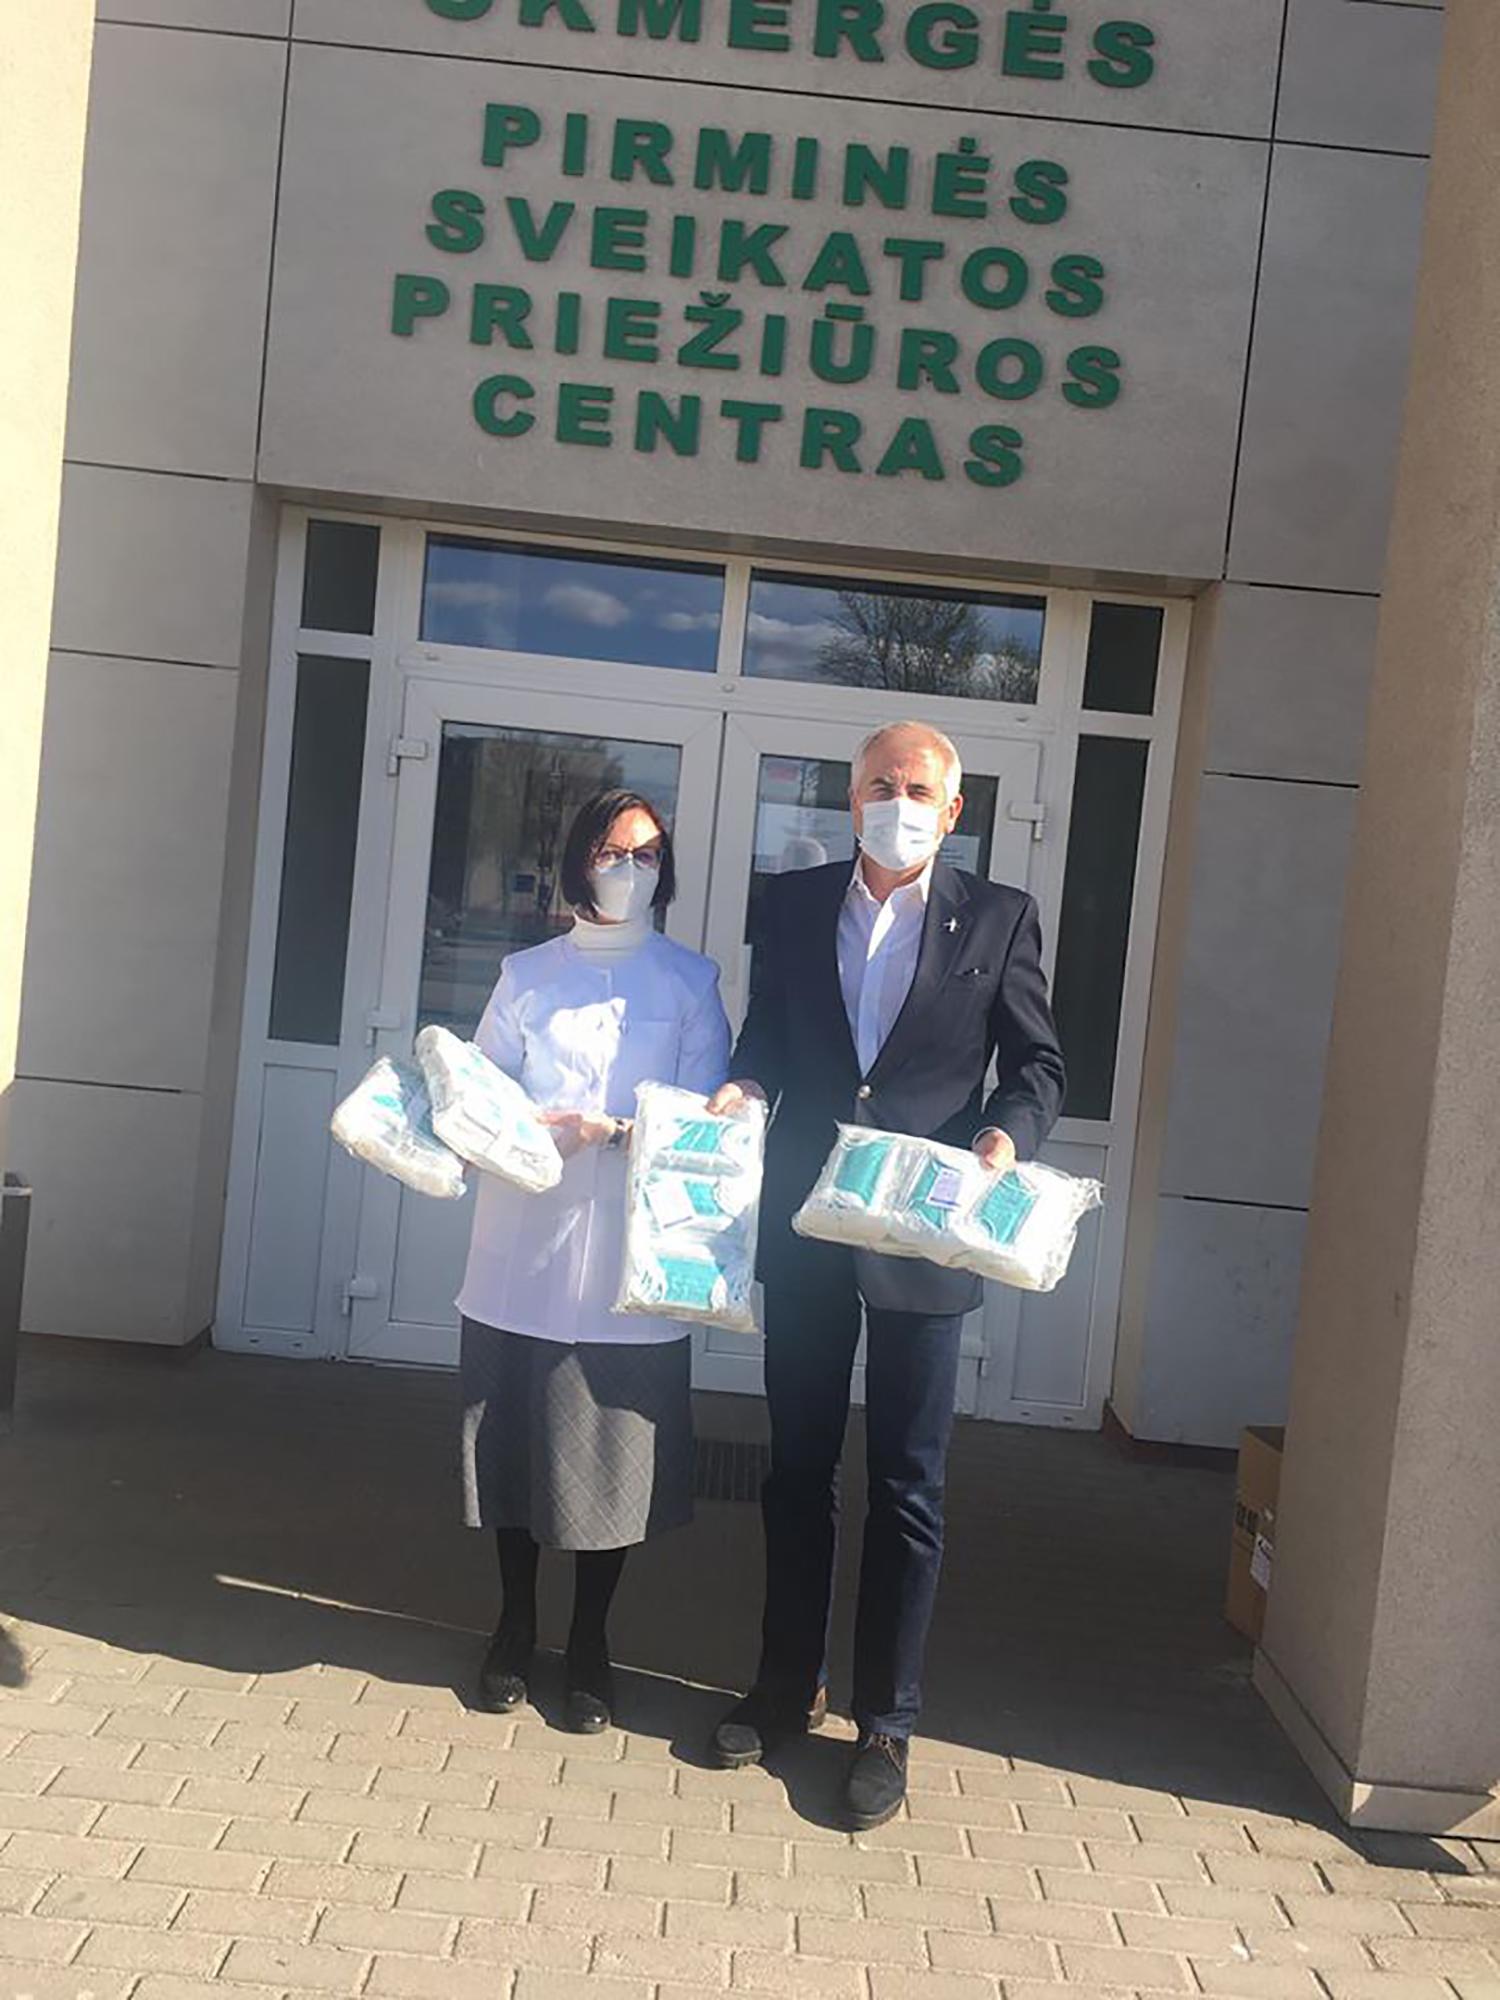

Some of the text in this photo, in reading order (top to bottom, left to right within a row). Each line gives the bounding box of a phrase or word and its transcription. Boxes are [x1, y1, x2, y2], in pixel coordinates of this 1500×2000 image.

[481, 103, 1069, 224] PIRMINĖS
[426, 190, 1105, 317] SVEIKATOS
[391, 275, 1121, 407] PRIEŽIŪROS
[472, 375, 1024, 487] CENTRAS
